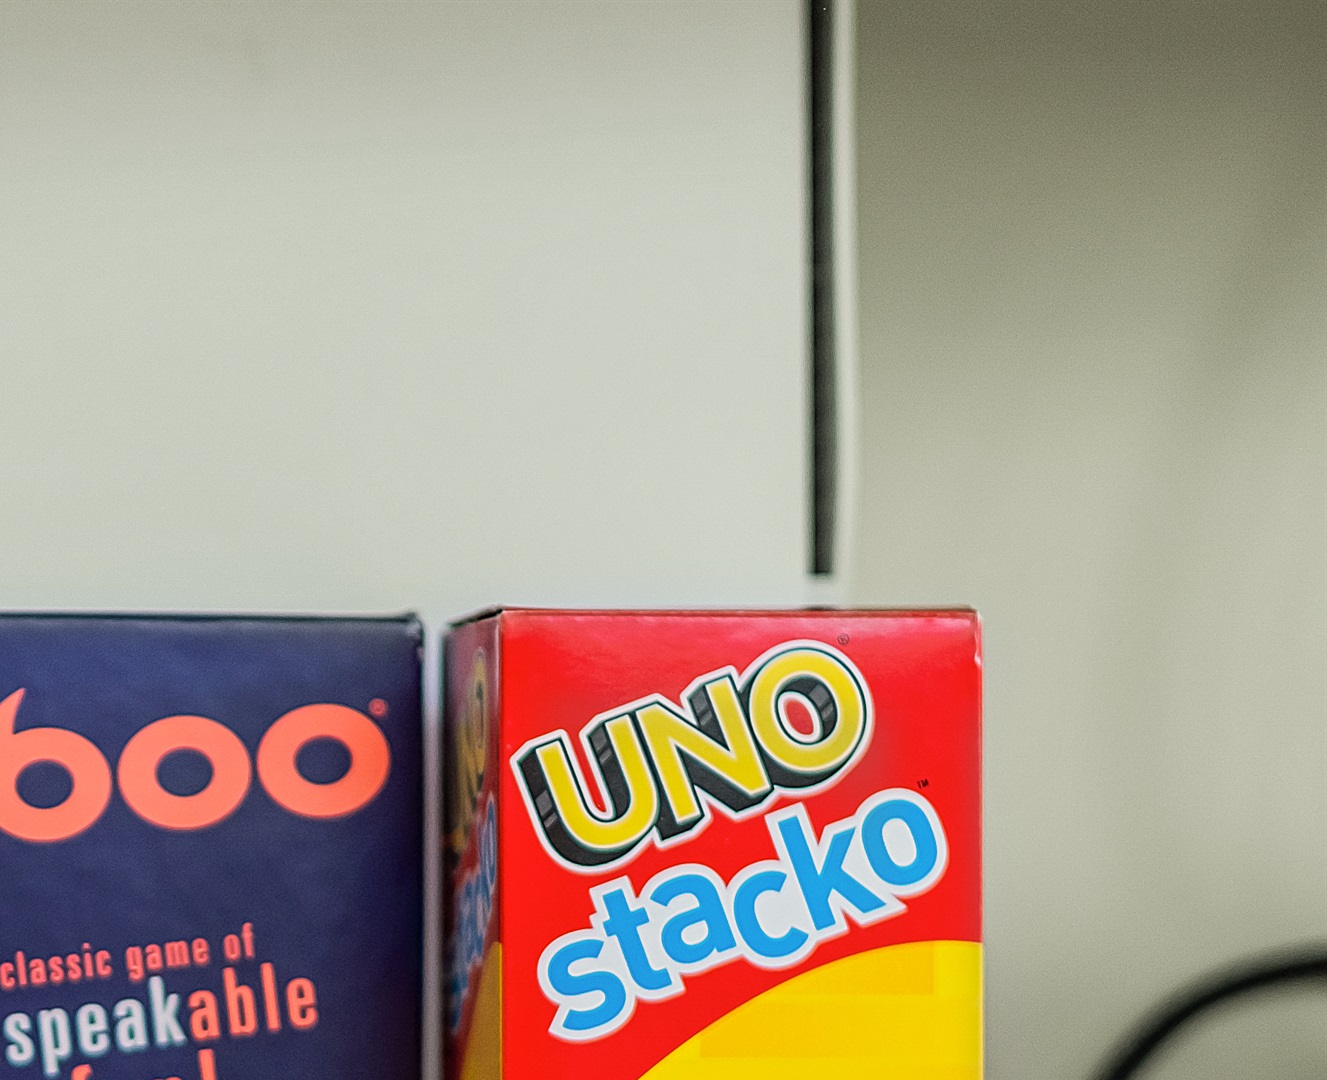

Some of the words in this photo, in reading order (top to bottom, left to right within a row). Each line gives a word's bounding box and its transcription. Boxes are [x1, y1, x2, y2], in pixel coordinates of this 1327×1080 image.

[517, 646, 868, 866] UNO
[0, 943, 112, 990] classic
[126, 937, 210, 981] game
[223, 922, 255, 961] of
[547, 798, 939, 1031] stacko
